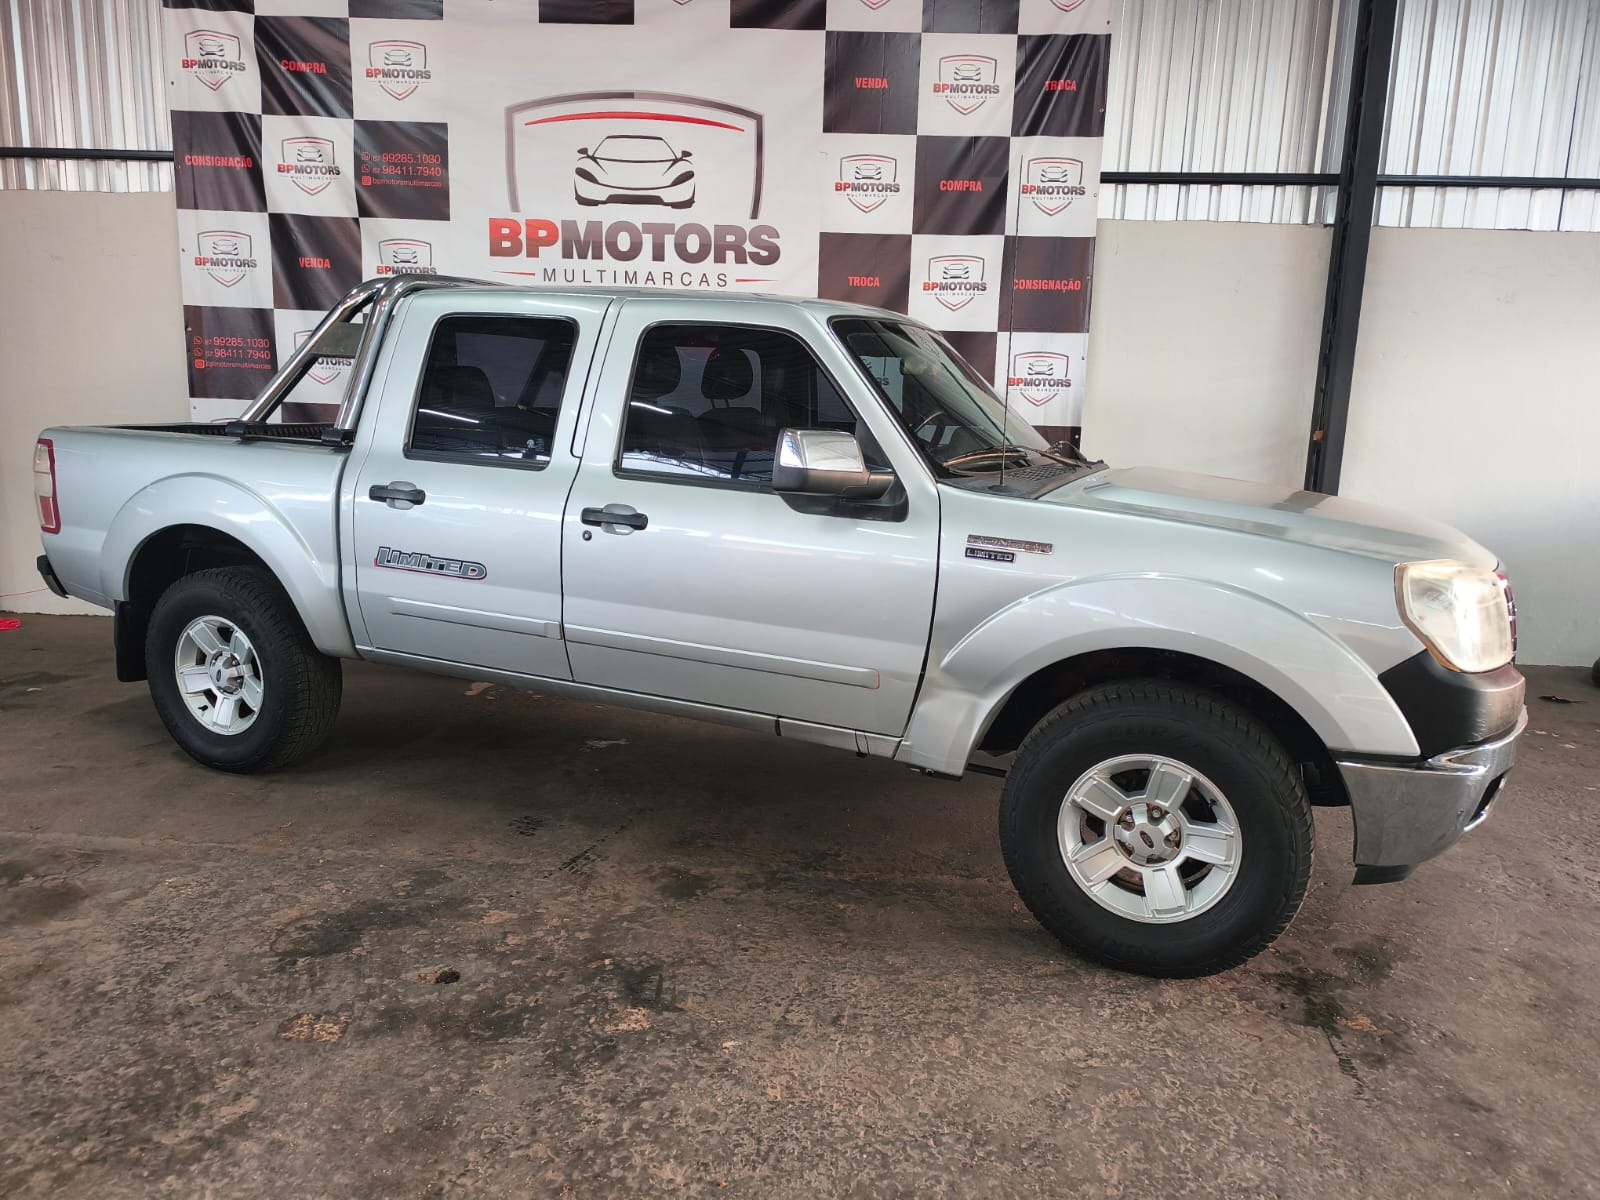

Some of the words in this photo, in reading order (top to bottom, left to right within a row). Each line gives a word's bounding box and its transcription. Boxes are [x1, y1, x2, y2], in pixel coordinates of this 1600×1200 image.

[181, 59, 246, 72] BPMOTORS
[281, 59, 327, 74] COMPRA
[365, 67, 432, 80] BPMOTORS
[855, 77, 889, 90] VENDA
[932, 82, 1000, 95] BPMOTORS
[1044, 79, 1077, 92] TROCA
[184, 154, 253, 170] CONSIGNAÇÃO
[276, 163, 341, 176] BPMOTORS
[382, 165, 442, 177] 98411.7940
[834, 182, 901, 193] BPMOTORS
[939, 180, 983, 192] COMPRA
[1021, 184, 1086, 196] BPMOTORS
[488, 217, 781, 266] BPMOTORS
[194, 256, 258, 269] BPMOTORS
[298, 256, 332, 270] VENDA
[542, 267, 728, 288] MULTIMARCAS
[848, 275, 881, 288] TROCA
[922, 281, 988, 292] BPMOTORS
[1013, 278, 1082, 293] CONSIGNAÇÃO
[213, 336, 270, 348] 99285.1030
[214, 348, 271, 360] 98411.7940
[1008, 377, 1072, 388] BPMOTORS
[966, 548, 1015, 562] LIMITED
